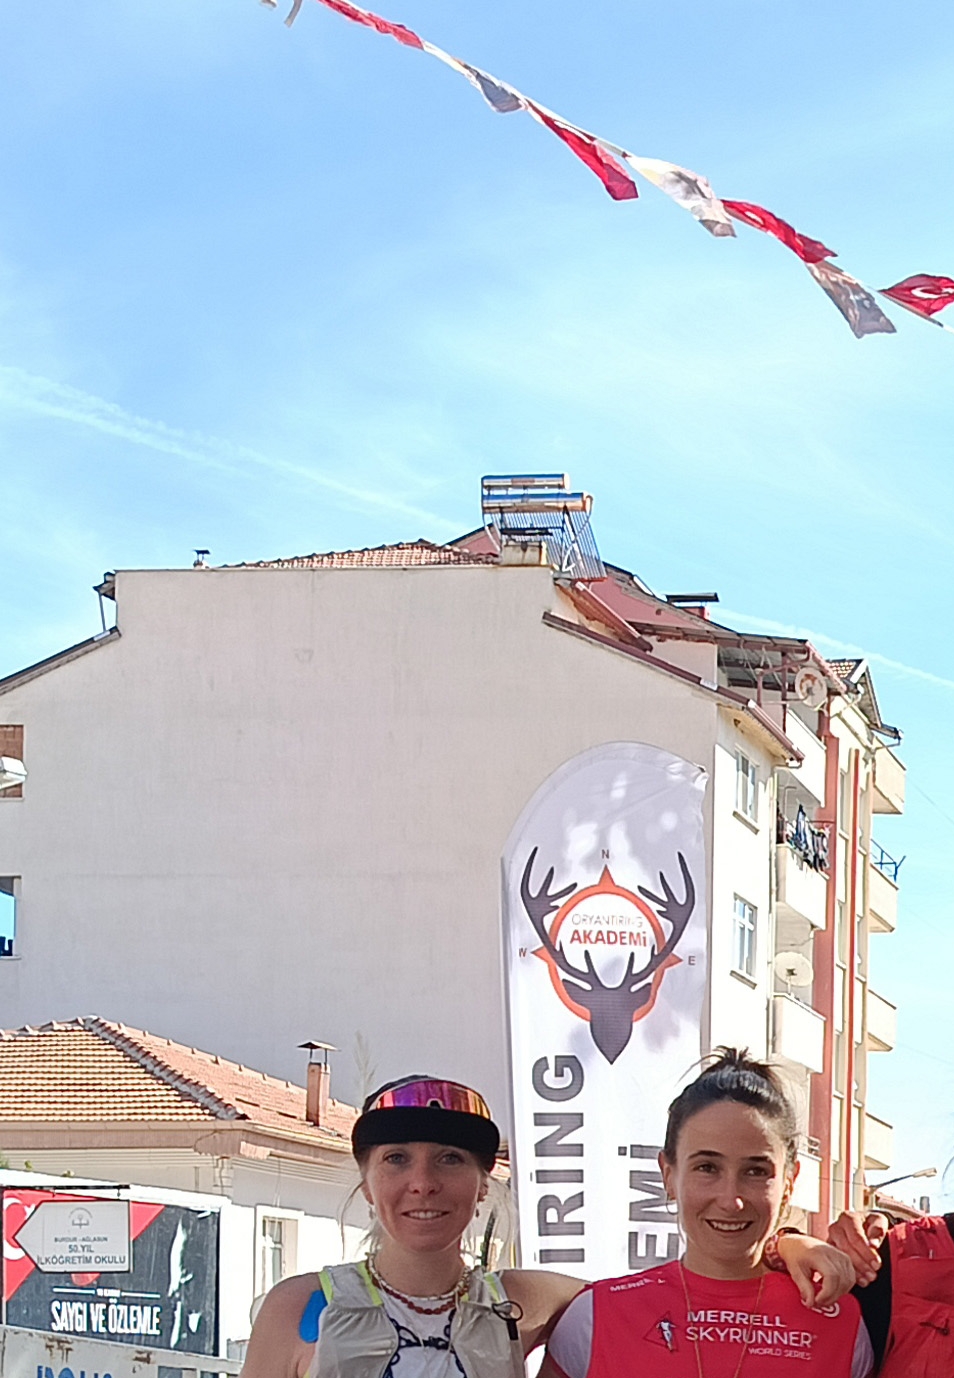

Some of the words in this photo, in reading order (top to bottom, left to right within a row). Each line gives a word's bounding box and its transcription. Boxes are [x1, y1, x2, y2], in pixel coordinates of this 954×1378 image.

[601, 849, 610, 859] N
[688, 955, 696, 965] E
[94, 1255, 126, 1265] OKULU
[51, 1300, 87, 1332] SAYGI
[90, 1302, 107, 1334] VE
[108, 1298, 161, 1335] ÖZLEMLE
[687, 1310, 787, 1328] MERRELL
[748, 1347, 781, 1357] WORLD
[784, 1349, 812, 1360] SERIES
